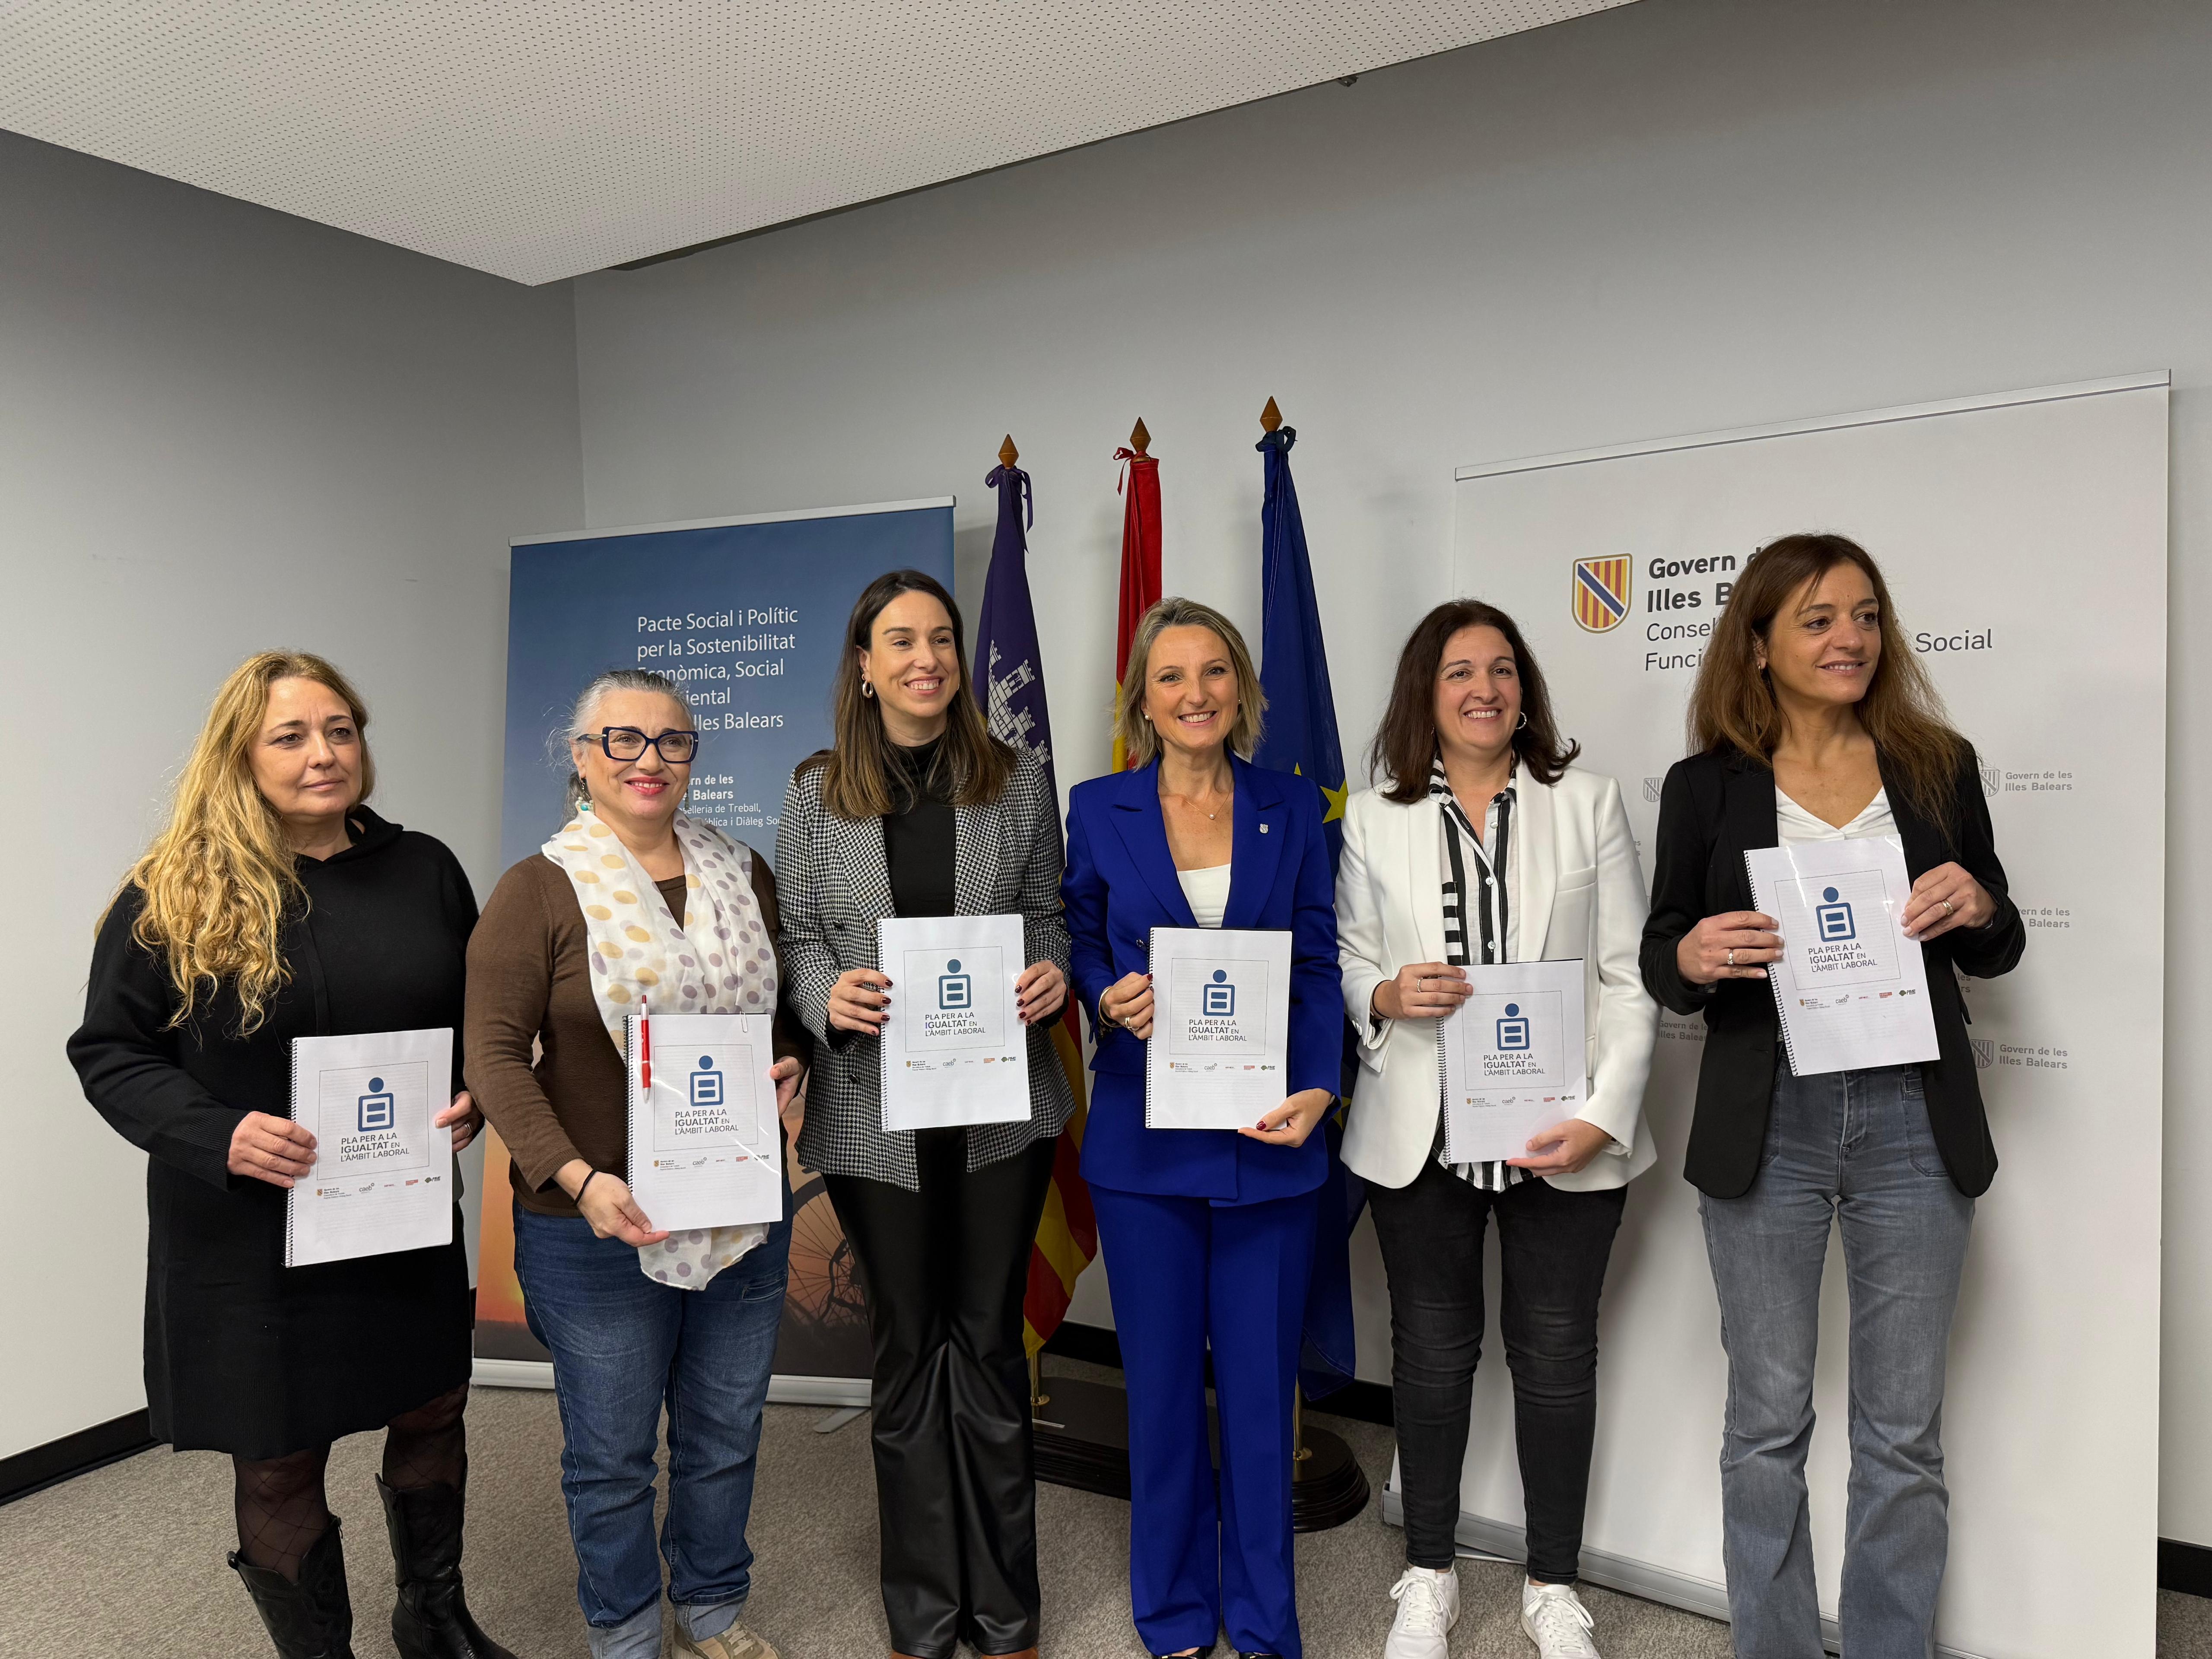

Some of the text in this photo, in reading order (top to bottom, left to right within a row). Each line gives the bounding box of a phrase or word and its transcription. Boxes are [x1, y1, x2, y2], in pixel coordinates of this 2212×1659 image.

[1648, 555, 1735, 579] Govern
[1647, 588, 1701, 613] Illes
[638, 607, 798, 632] Pacte Social i Polític
[1915, 628, 1993, 653] Social
[637, 634, 795, 662] per la Sostenibilitat
[1645, 648, 1702, 671] Funci
[638, 658, 784, 680] onòmica, Social
[694, 712, 784, 731] lles Balears
[705, 775, 716, 785] de
[719, 774, 734, 784] les
[2005, 782, 2072, 791] Illes Balears
[693, 789, 734, 801] Balears
[715, 804, 725, 813] de
[728, 803, 761, 813] Treball,
[731, 817, 733, 826] i
[736, 817, 764, 827] Diàleg
[2056, 908, 2070, 916] les
[2029, 918, 2070, 928] Balears
[1810, 952, 1854, 964] IGUALTAT
[1812, 959, 1878, 973] L'ÀMBIT LABORAL
[925, 1020, 967, 1029] IGUALTAT
[1661, 1030, 1675, 1039] lles
[2000, 1044, 2067, 1057] Govern de les
[1484, 1061, 1526, 1069] IGUALTAT
[1999, 1055, 2067, 1069] Illes Balears
[675, 1117, 719, 1127] IGUALTAT
[675, 1125, 739, 1135] L'ÀMBIT LABORAL
[341, 1141, 389, 1154] IGUALTAT
[341, 1148, 410, 1162] L'ÀMBIT LABORAL
